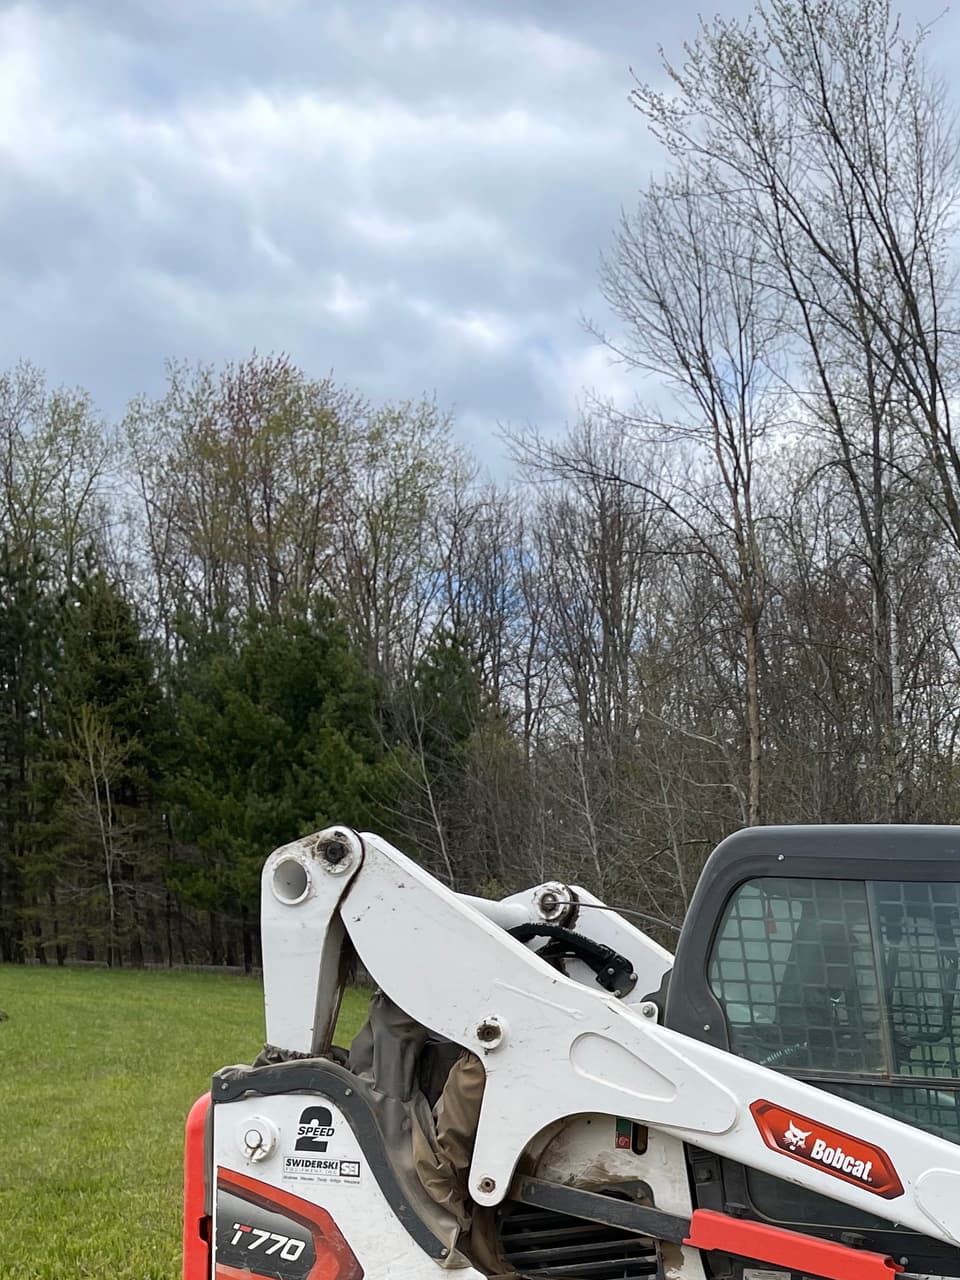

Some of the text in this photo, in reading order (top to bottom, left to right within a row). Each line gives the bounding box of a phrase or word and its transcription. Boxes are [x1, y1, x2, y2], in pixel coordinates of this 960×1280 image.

[295, 1106, 333, 1152] 2
[297, 1126, 335, 1137] SPEED
[285, 1158, 339, 1170] SWIDERSKI
[811, 1138, 873, 1182] Bobcat
[230, 1223, 306, 1261] T770
